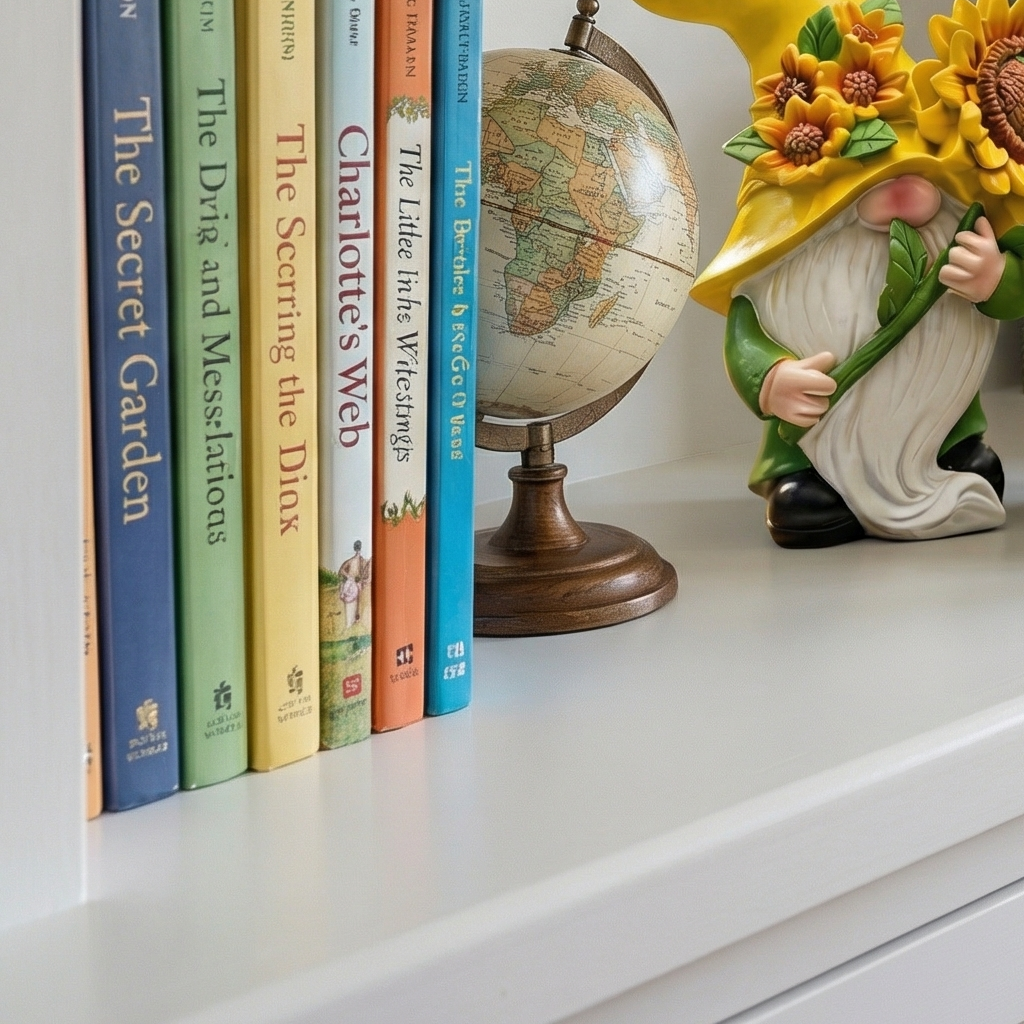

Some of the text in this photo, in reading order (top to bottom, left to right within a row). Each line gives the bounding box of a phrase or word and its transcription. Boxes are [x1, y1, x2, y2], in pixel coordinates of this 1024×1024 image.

[196, 77, 227, 147] The
[276, 124, 308, 202] The
[398, 143, 422, 188] The
[113, 97, 162, 525] The Secret Garden
[201, 260, 230, 318] and
[337, 125, 371, 449] Charlotte's Web
[279, 374, 305, 428] the
